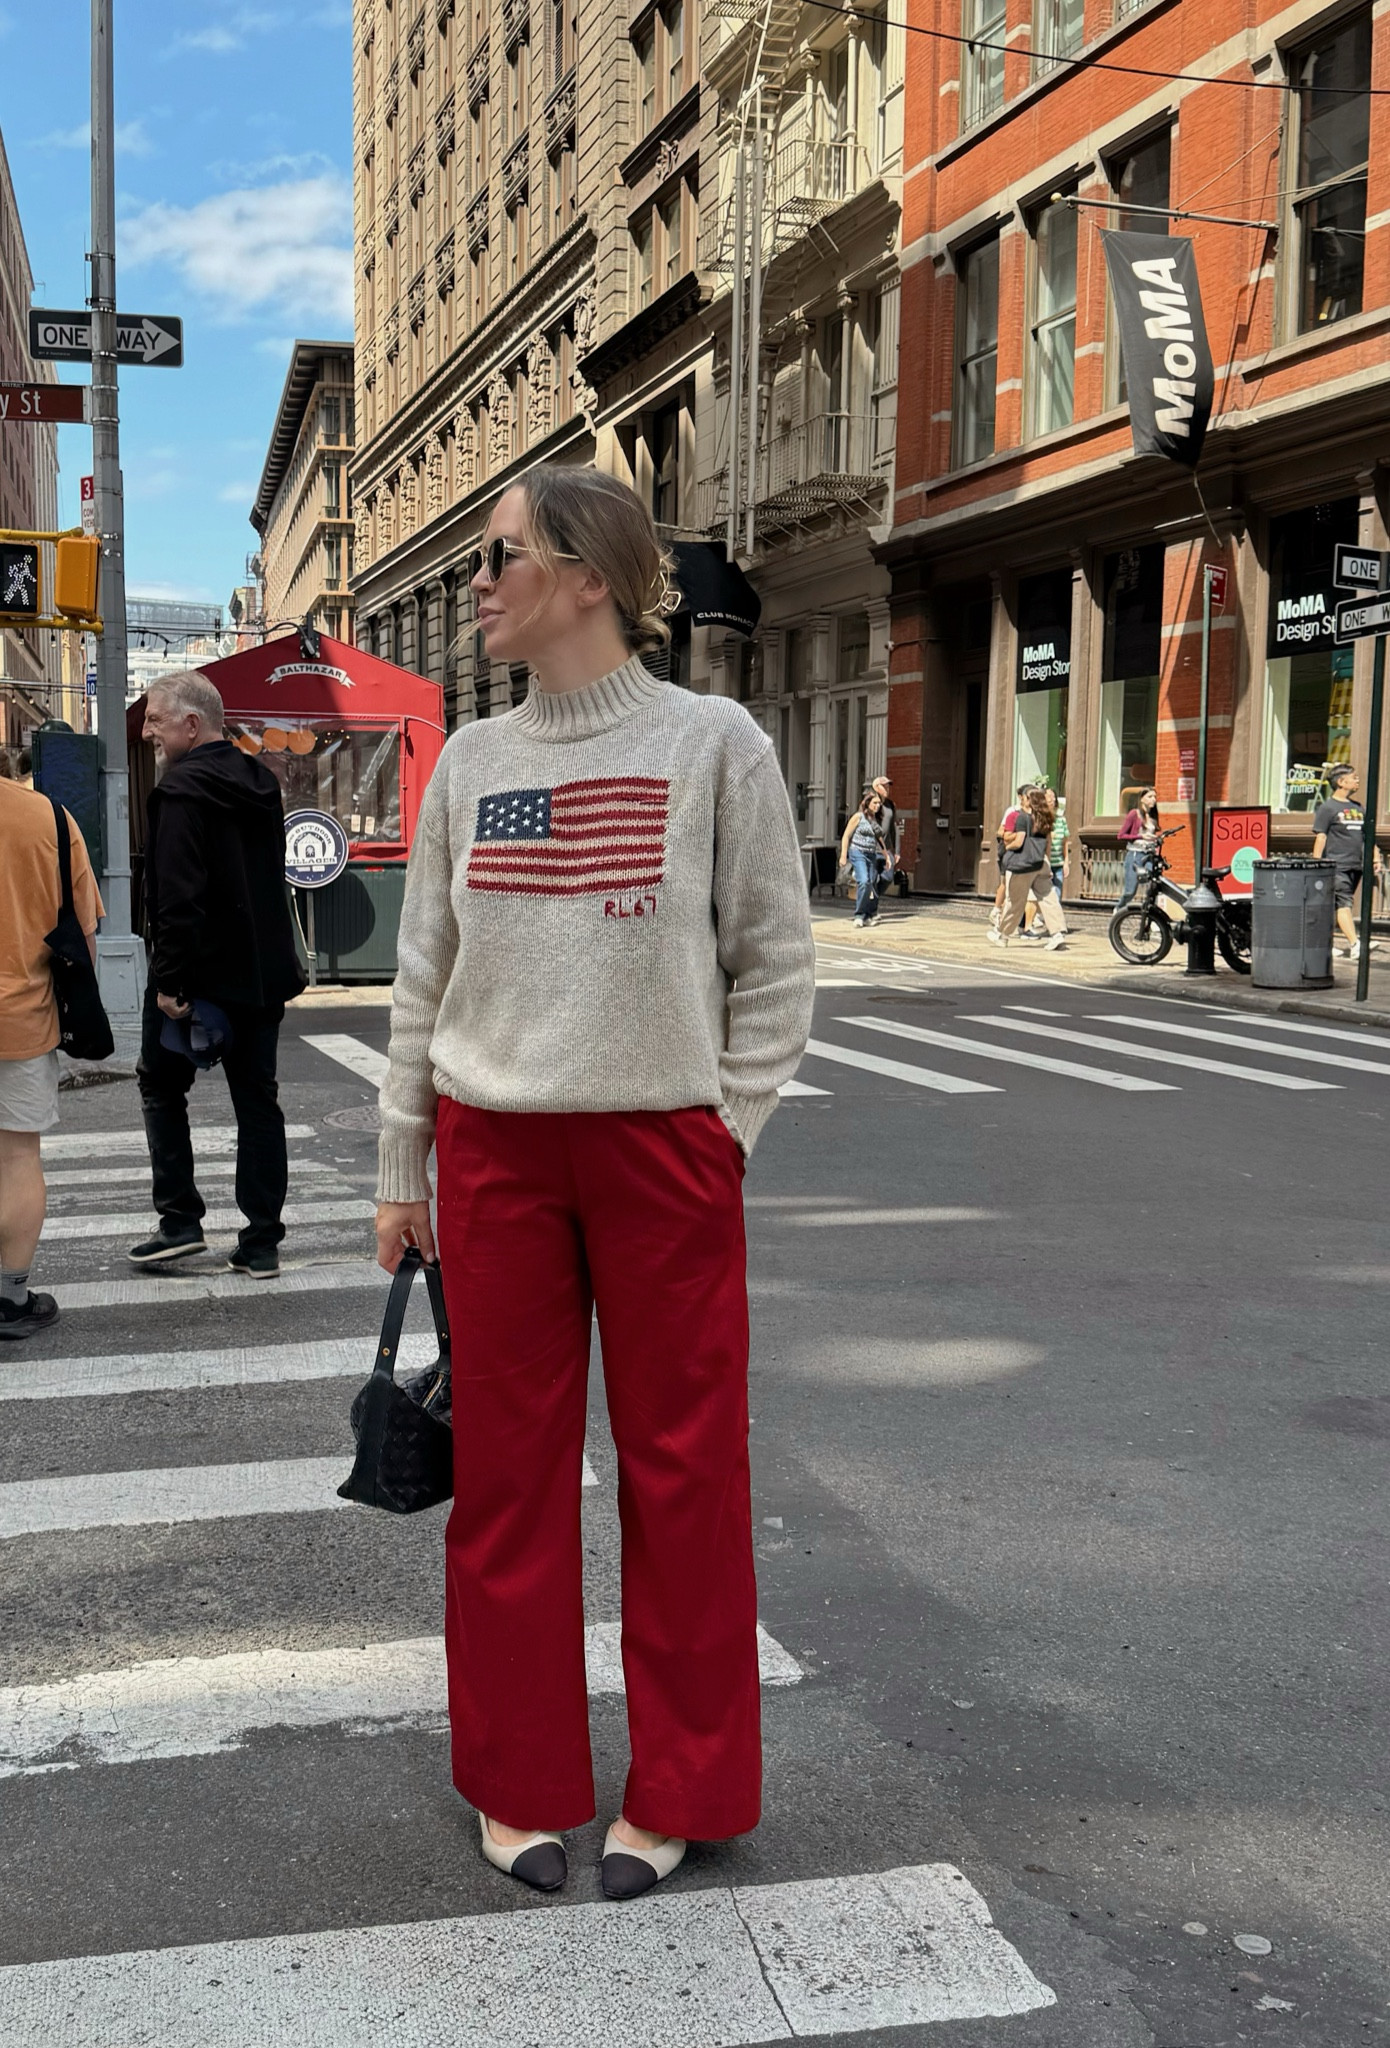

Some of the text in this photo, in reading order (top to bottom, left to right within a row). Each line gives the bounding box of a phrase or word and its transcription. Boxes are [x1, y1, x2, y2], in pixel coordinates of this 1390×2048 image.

[43, 326, 161, 350] ONE WAY
[1131, 257, 1196, 438] MoMA
[20, 390, 41, 414] St
[1350, 560, 1377, 578] ONE
[696, 611, 724, 619] CLUB
[1278, 594, 1325, 620] MoMA
[1344, 604, 1390, 629] ONE W
[1277, 615, 1336, 642] Design St
[1023, 642, 1055, 664] MoMA
[279, 664, 342, 678] BALTHAZAR
[1022, 660, 1070, 681] Design Stor
[295, 824, 332, 845] OUTDOOR
[1216, 816, 1263, 841] Sale
